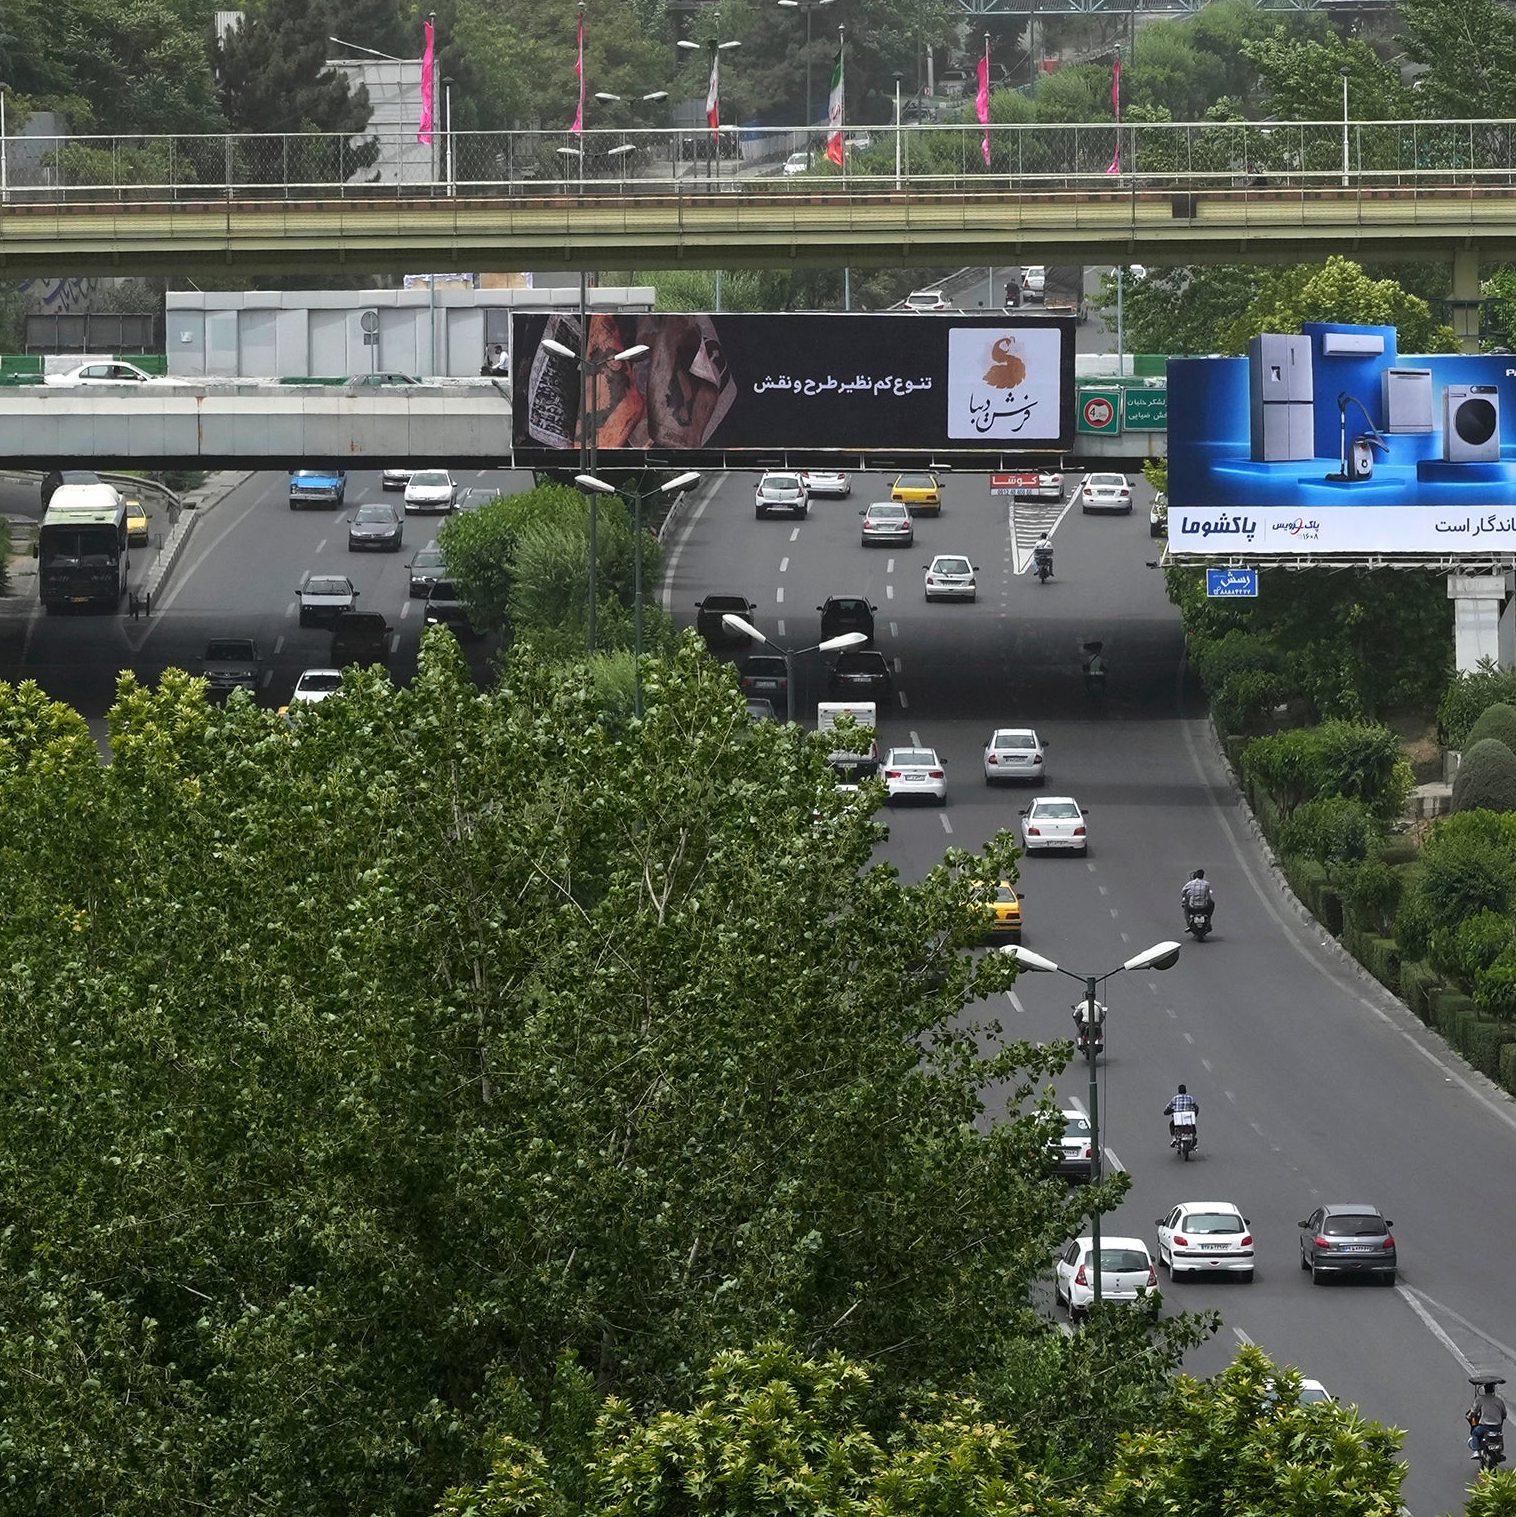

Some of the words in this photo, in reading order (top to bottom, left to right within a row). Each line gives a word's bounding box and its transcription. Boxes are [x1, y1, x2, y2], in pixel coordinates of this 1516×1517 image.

[753, 375, 792, 394] نقش
[793, 379, 802, 394] و
[804, 375, 838, 396] طرح
[893, 377, 932, 396] تنوع
[969, 393, 991, 425] دیبا
[976, 392, 1038, 433] فرش
[992, 475, 1038, 487] کوشا
[1181, 513, 1257, 542] پاکشوما
[1435, 517, 1470, 532] است
